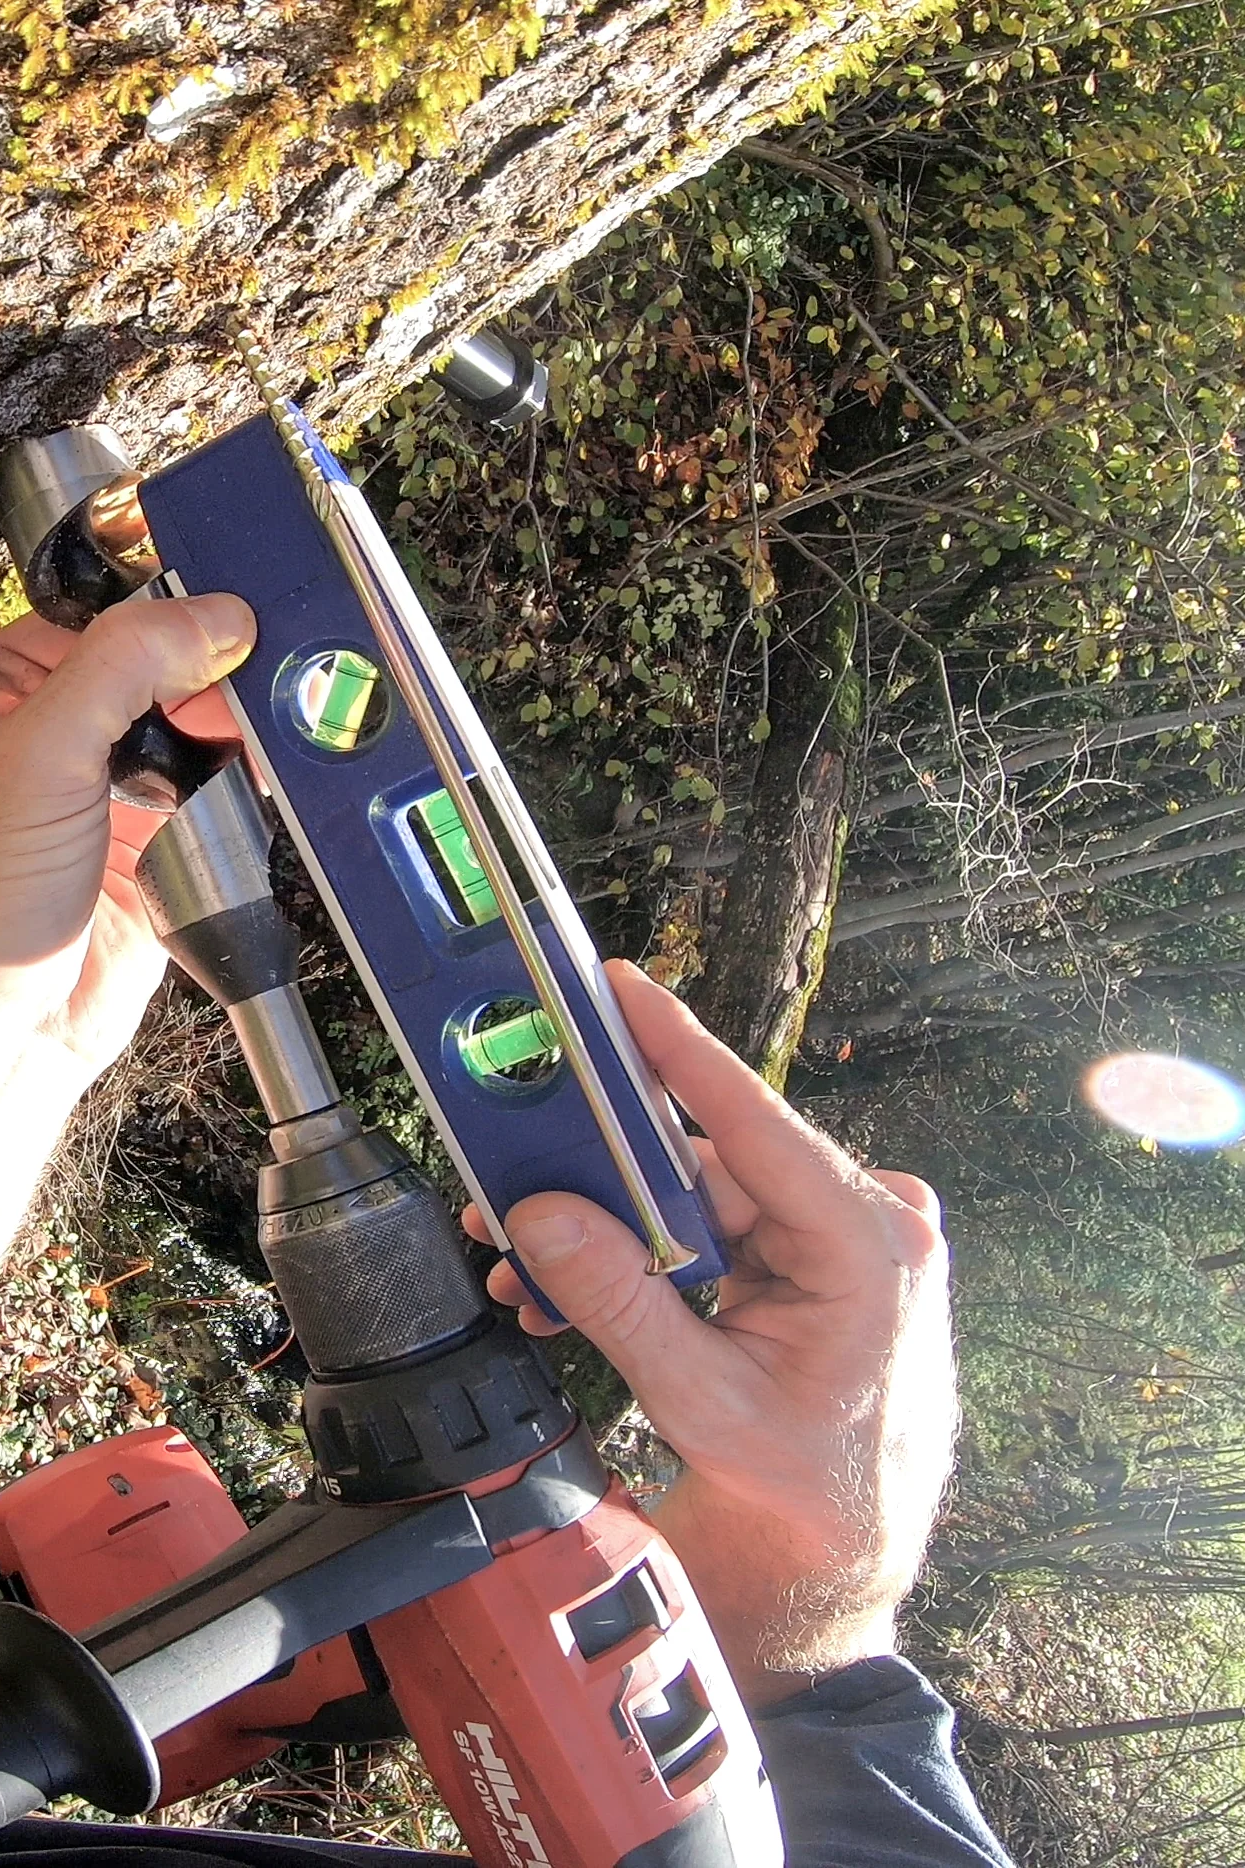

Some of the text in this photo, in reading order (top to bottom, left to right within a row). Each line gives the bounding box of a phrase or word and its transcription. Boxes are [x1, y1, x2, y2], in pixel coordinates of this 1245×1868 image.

[321, 1475, 342, 1496] 15
[453, 1729, 477, 1764] SF
[469, 1768, 524, 1868] 10W-A22
